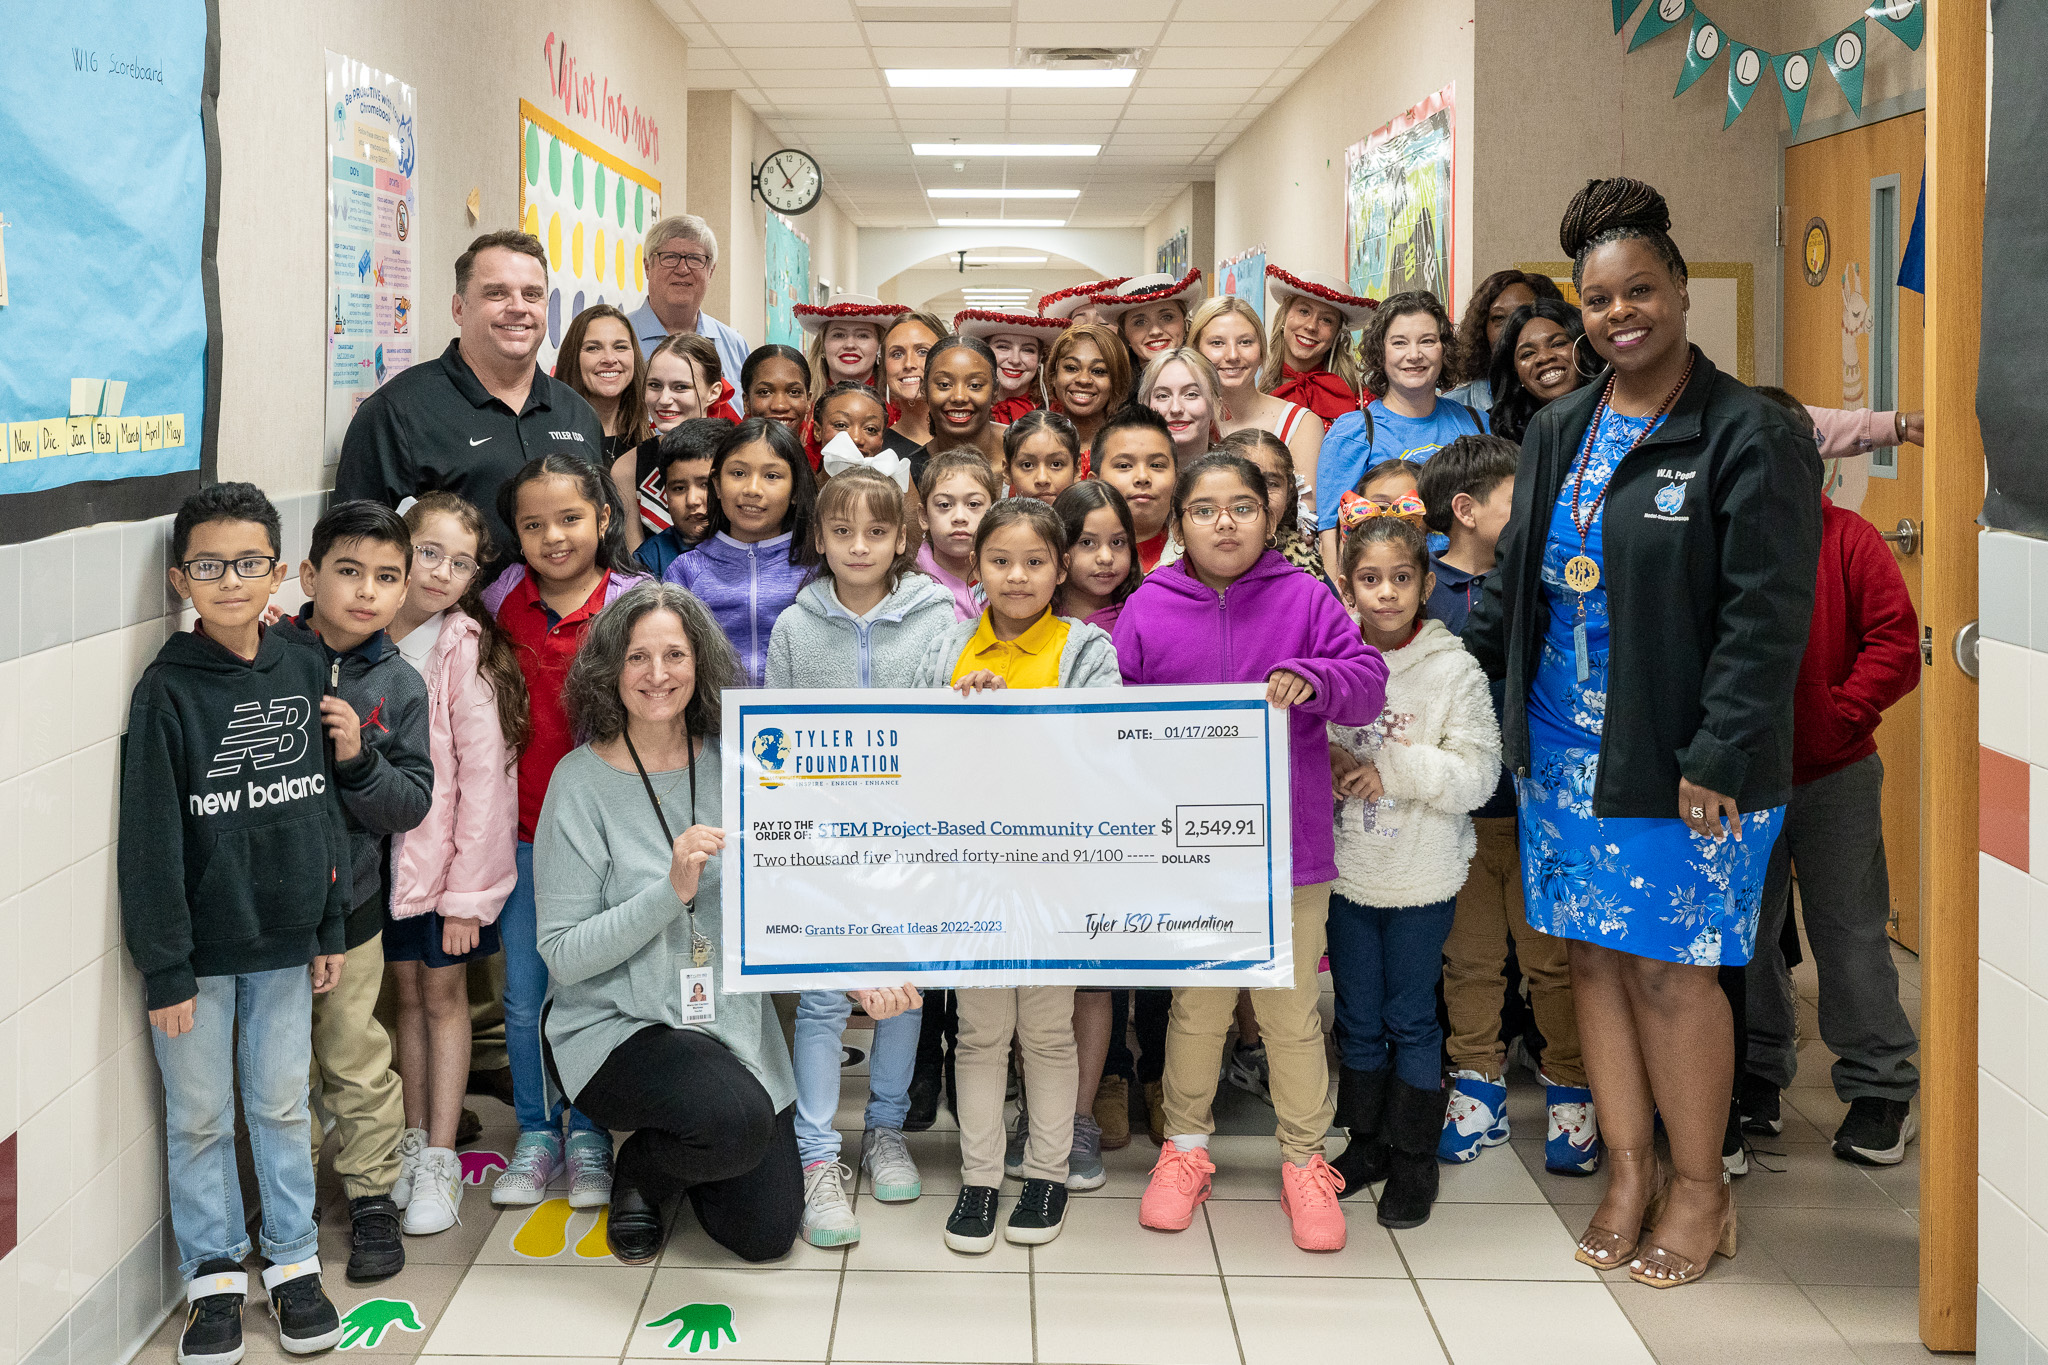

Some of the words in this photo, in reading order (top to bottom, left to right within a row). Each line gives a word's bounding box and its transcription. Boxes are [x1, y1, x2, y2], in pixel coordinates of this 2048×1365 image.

[72, 47, 98, 72] WIG
[109, 53, 163, 85] Scoreboard
[14, 429, 32, 454] Nov.
[43, 427, 60, 450] Dic.
[121, 423, 140, 444] March
[145, 421, 160, 446] April
[166, 420, 182, 444] May
[548, 431, 572, 440] TYLER
[795, 730, 853, 747] TYLER
[867, 730, 898, 747] ISD
[1118, 729, 1152, 740] DATE:
[1164, 725, 1239, 738] 01/17/2023
[796, 755, 899, 773] FOUNDATION
[190, 790, 241, 816] new
[753, 821, 774, 830] PAY
[777, 821, 792, 830] TO
[794, 820, 814, 830] THE
[818, 822, 868, 838] STEM
[872, 821, 986, 838] Project-Based
[990, 821, 1094, 838] Community
[1098, 822, 1156, 836] Center
[1161, 818, 1173, 835] $
[1185, 820, 1256, 838] 2,549.91
[755, 831, 791, 840] ORDER
[794, 830, 812, 840] OF:
[753, 853, 787, 866] Two
[791, 851, 860, 866] thousand
[863, 850, 892, 864] five
[895, 850, 958, 863] hundred
[963, 849, 1038, 864] forty-nine
[1042, 849, 1069, 862] and
[1073, 849, 1124, 863] 91/100
[1161, 855, 1211, 864] DOLLARS
[766, 924, 802, 934] MEMO:
[805, 924, 845, 935] Grants
[848, 924, 868, 934] For
[871, 923, 905, 934] Great
[908, 922, 938, 934] Ideas
[941, 920, 1003, 933] 2022-2023
[1085, 913, 1118, 940] Tyler
[1123, 913, 1153, 933] ISD
[1157, 913, 1234, 933] Foundation
